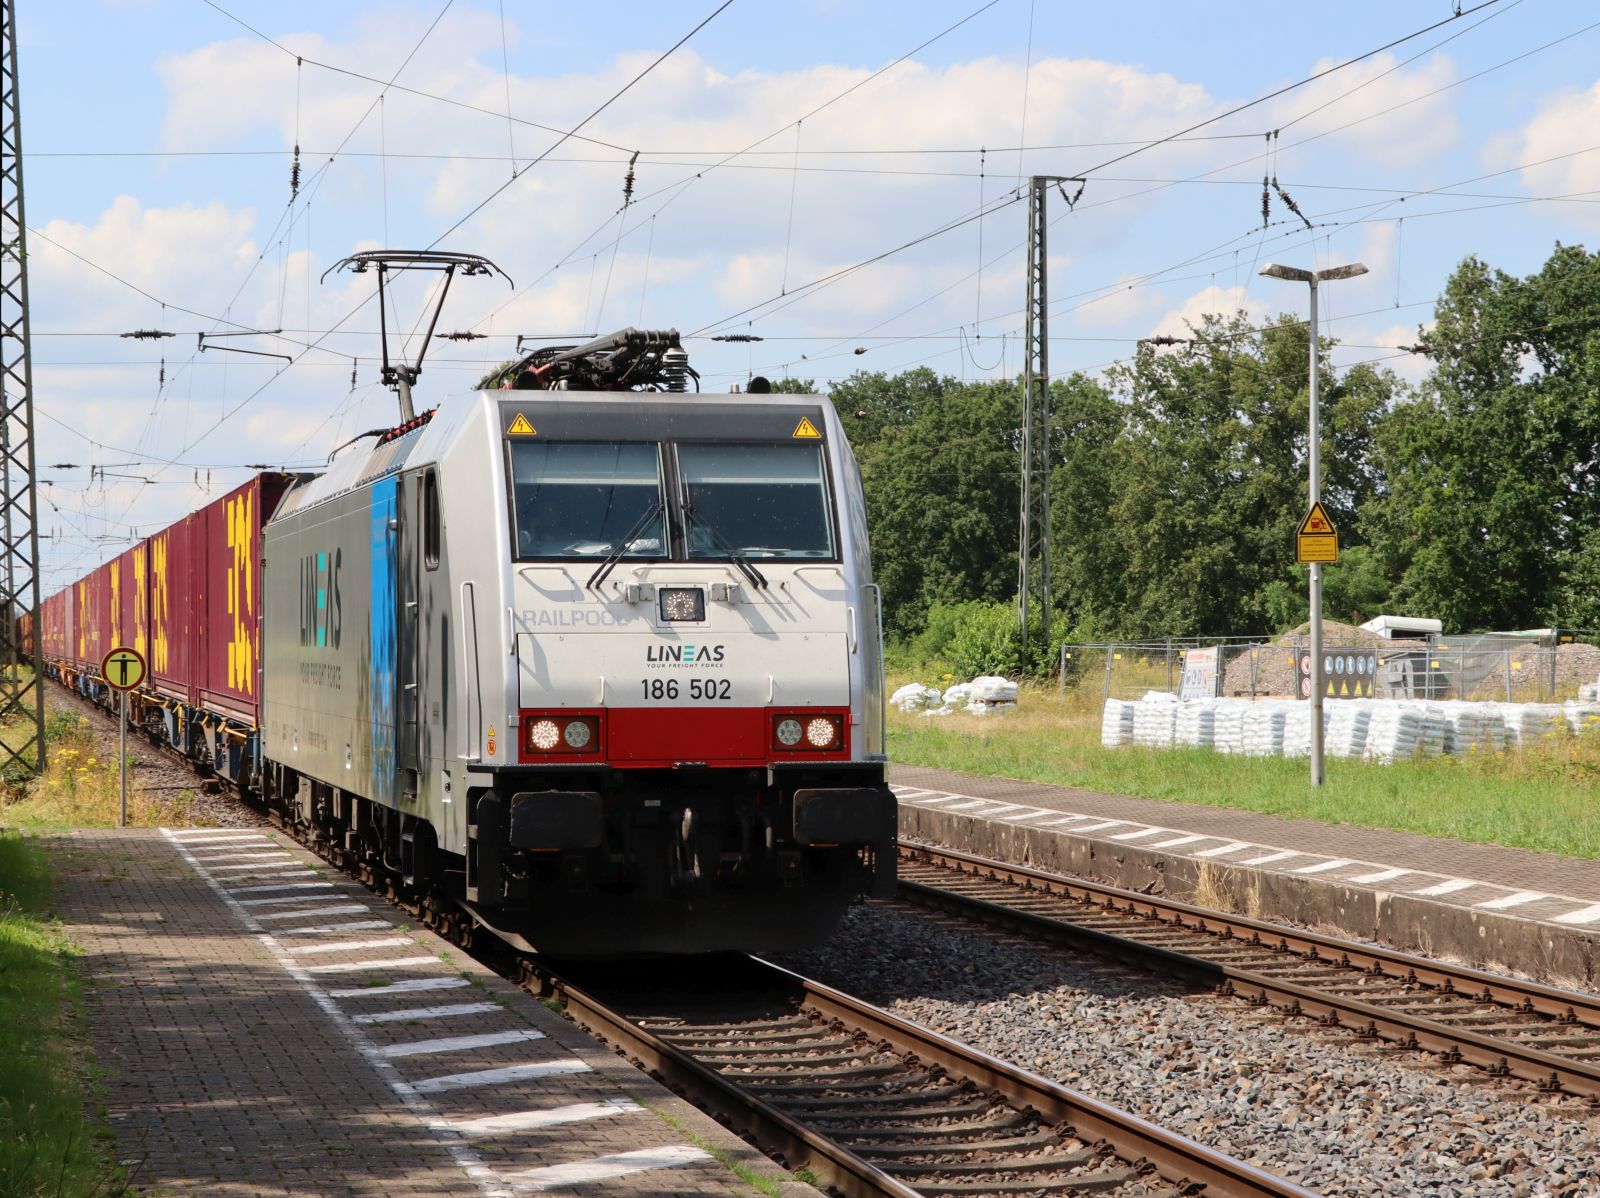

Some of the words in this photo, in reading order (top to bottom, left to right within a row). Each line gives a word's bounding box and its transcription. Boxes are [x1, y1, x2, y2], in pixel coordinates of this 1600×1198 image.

[300, 547, 342, 651] LINEAS
[647, 645, 725, 662] LINEAS
[641, 679, 679, 700] 186
[690, 679, 731, 700] 502
